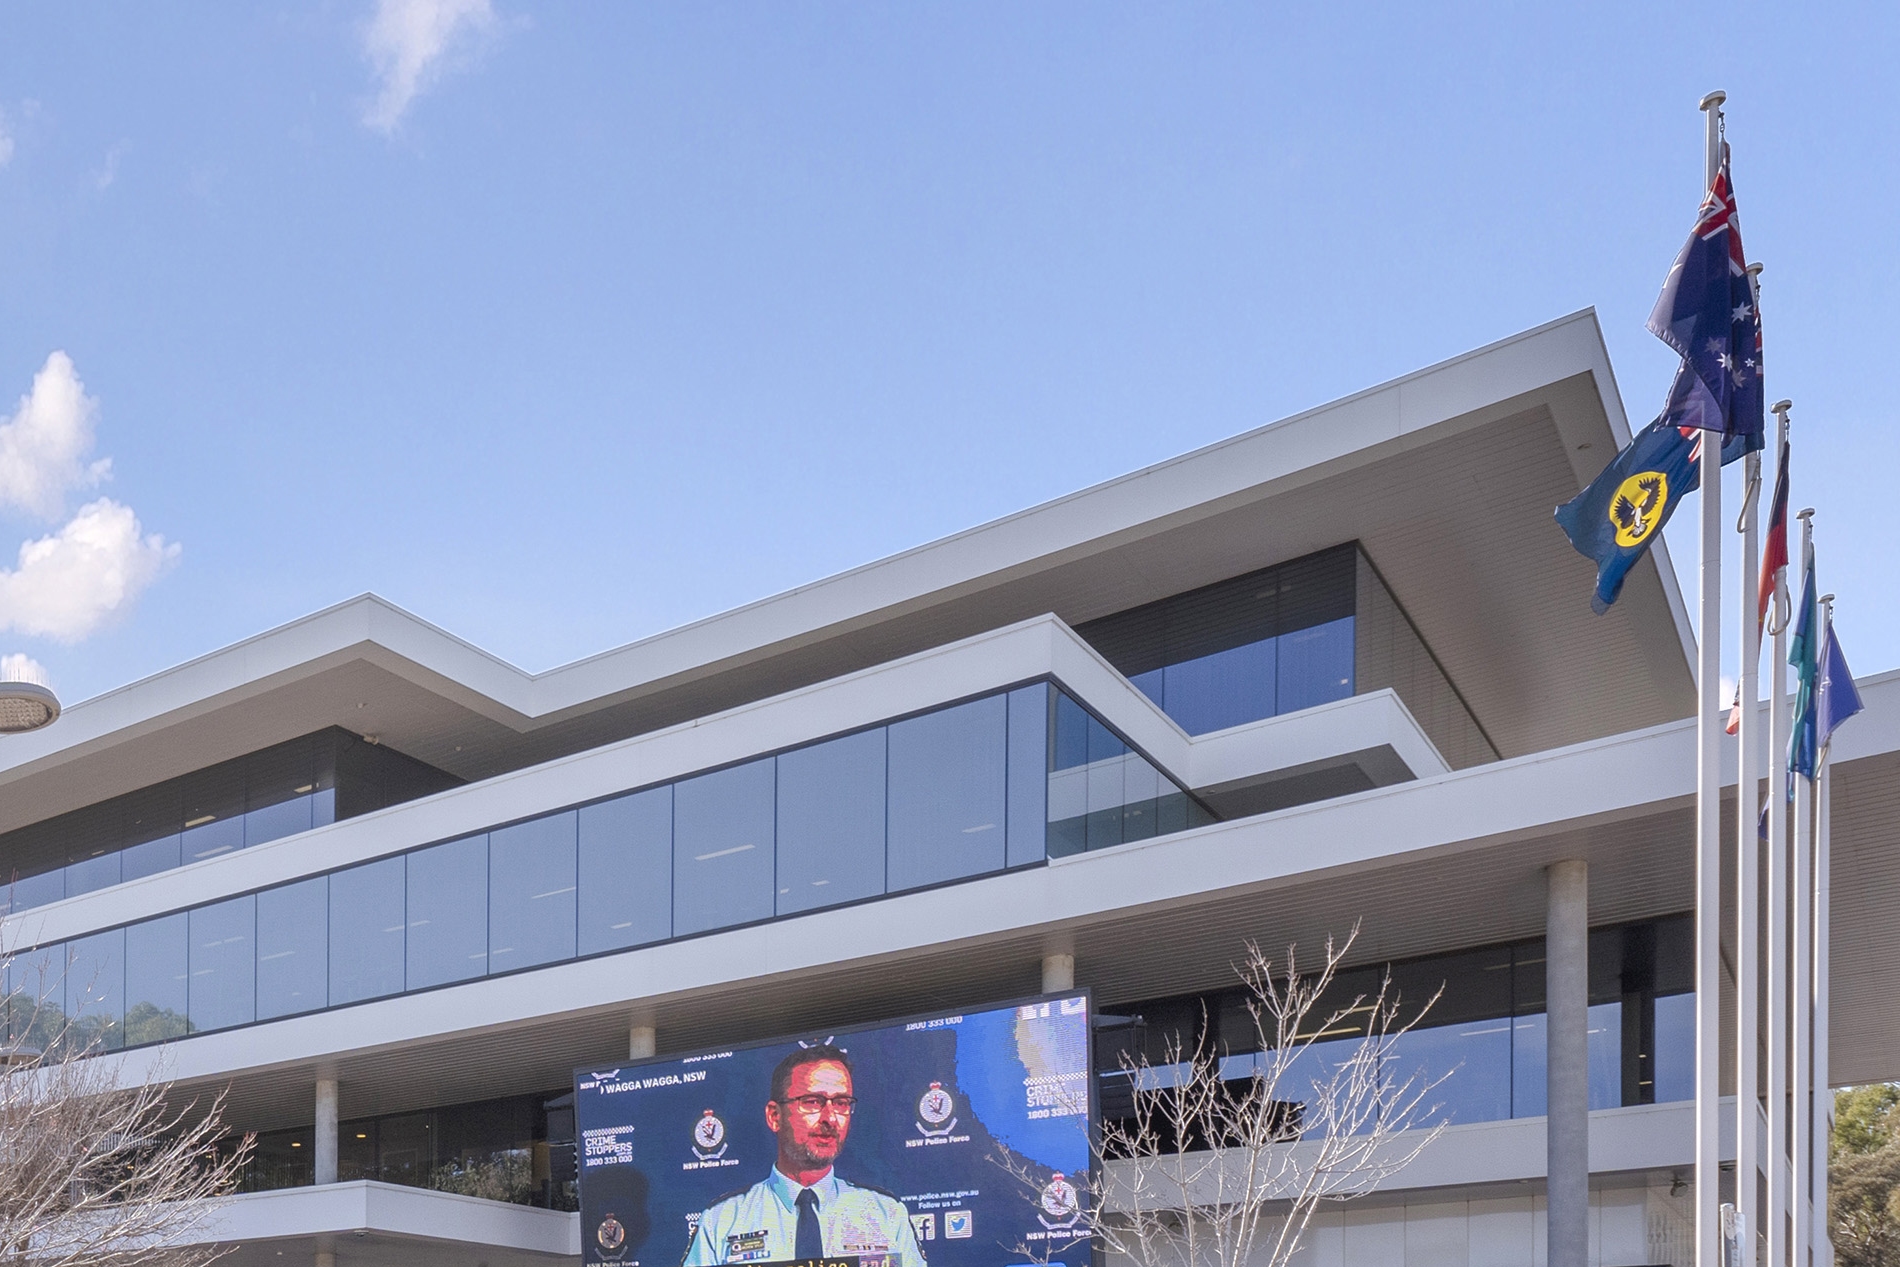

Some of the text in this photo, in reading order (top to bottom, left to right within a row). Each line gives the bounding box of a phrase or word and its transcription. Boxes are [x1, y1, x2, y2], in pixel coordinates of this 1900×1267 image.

[605, 1080, 642, 1094] WAGGA
[642, 1075, 682, 1089] WAGGA,
[683, 1070, 707, 1083] NSW
[585, 1135, 617, 1147] CRIME
[906, 1135, 970, 1148] NSW Police Force
[585, 1142, 633, 1156] STOPPERS
[586, 1155, 633, 1167] 1800 333 000
[683, 1158, 739, 1170] NSW Police Force
[918, 1201, 940, 1209] Follow
[1026, 1232, 1046, 1241] NSW
[1047, 1230, 1071, 1239] Police
